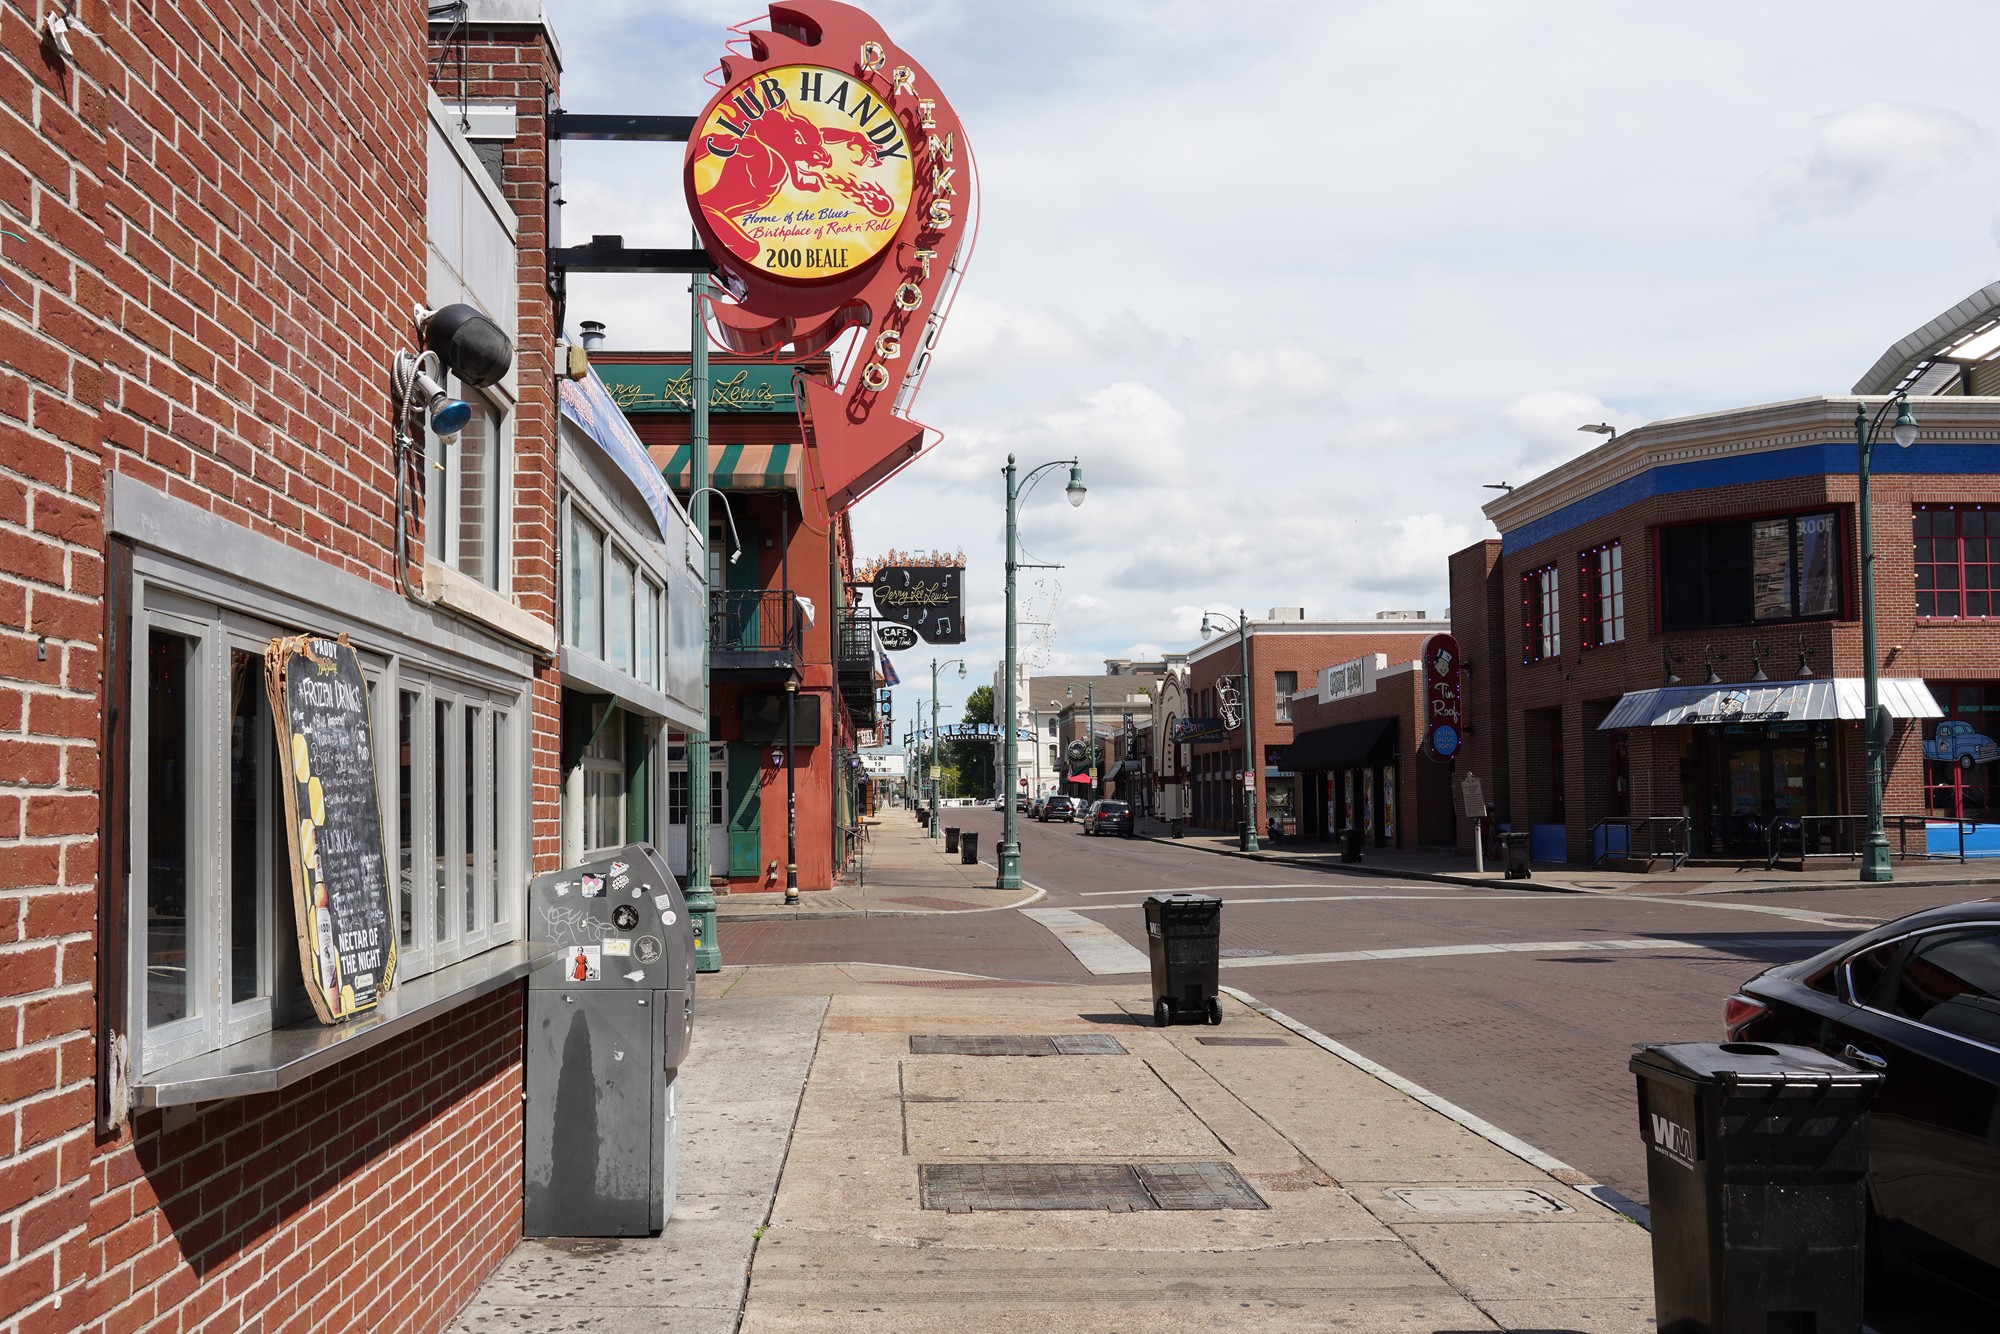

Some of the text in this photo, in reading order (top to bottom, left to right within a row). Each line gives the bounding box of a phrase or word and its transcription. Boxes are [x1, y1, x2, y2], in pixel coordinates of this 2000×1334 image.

[706, 71, 908, 161] CLUB HANDY
[742, 208, 856, 227] Home of the Blues
[859, 40, 958, 392] DRINKS TO GO
[748, 225, 813, 242] Birthplace
[814, 225, 825, 240] of
[826, 221, 852, 235] Rock
[864, 218, 898, 232] Roll
[766, 248, 849, 268] 200 BEALE
[711, 370, 776, 409] Lewis
[874, 580, 957, 607] Jerry Lee Lewis
[883, 628, 908, 637] CAFE
[314, 640, 338, 660] PADDY
[1434, 682, 1456, 700] Tin
[1432, 699, 1459, 724] Roof
[1725, 713, 1756, 721] MUSIC
[1126, 715, 1134, 760] MUSEUM
[338, 927, 379, 953] NECTAR OF
[340, 948, 381, 976] THE NIGHT
[1651, 1112, 1695, 1163] WM
